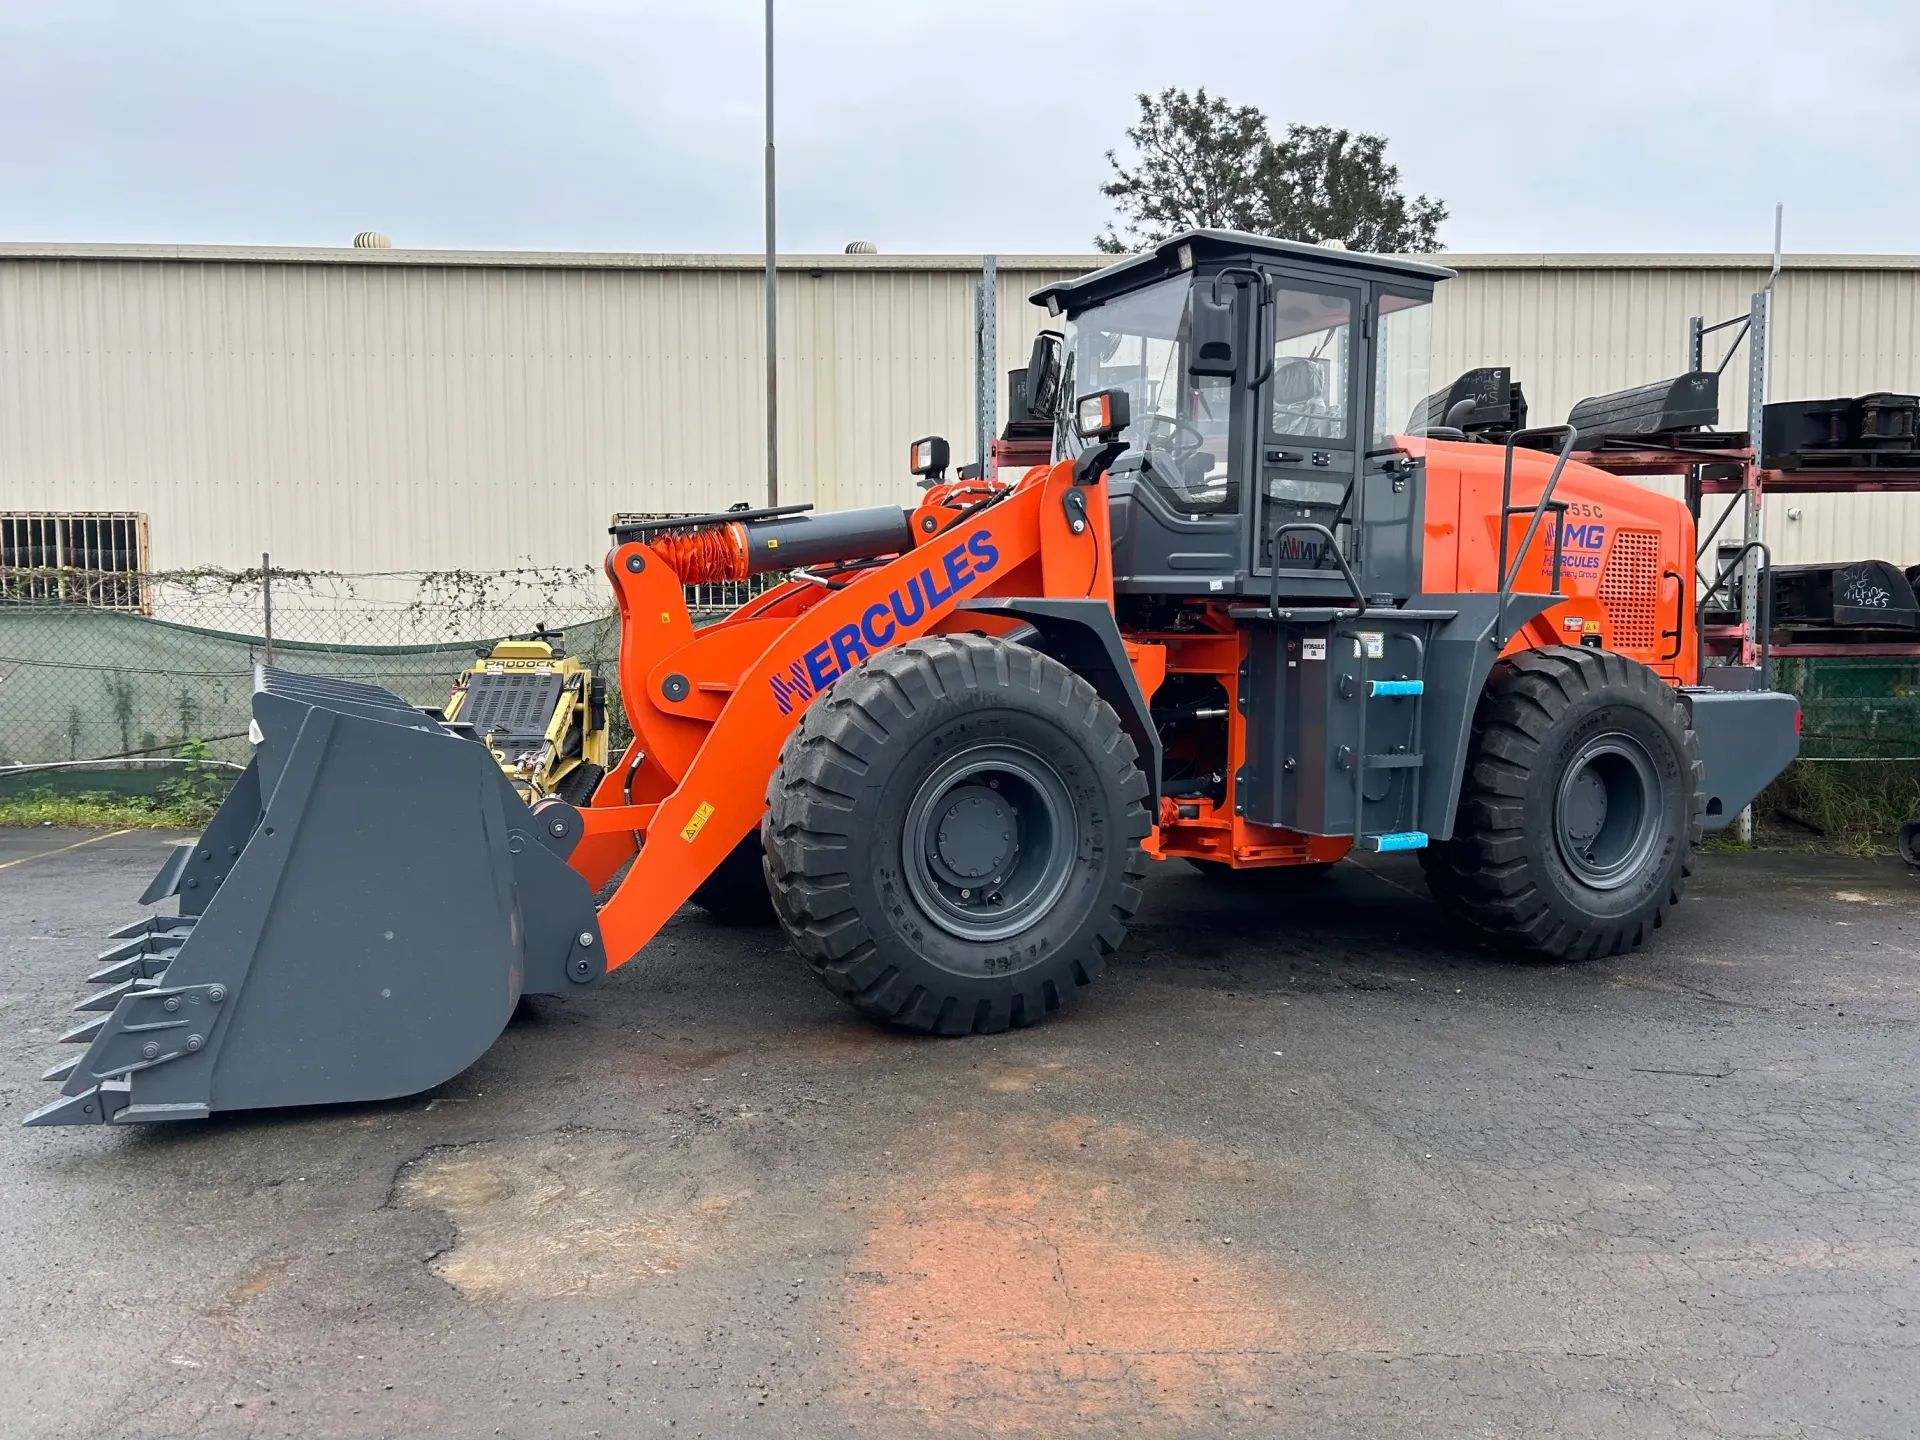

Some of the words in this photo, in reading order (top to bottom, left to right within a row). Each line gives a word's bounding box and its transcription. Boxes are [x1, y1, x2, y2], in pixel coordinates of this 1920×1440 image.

[1565, 502, 1603, 519] 55C
[1543, 555, 1600, 568] HRCULES
[1541, 569, 1577, 580] Mainery
[1578, 570, 1597, 580] Group
[769, 529, 1000, 717] HERCULES
[484, 659, 556, 668] PADDOCK
